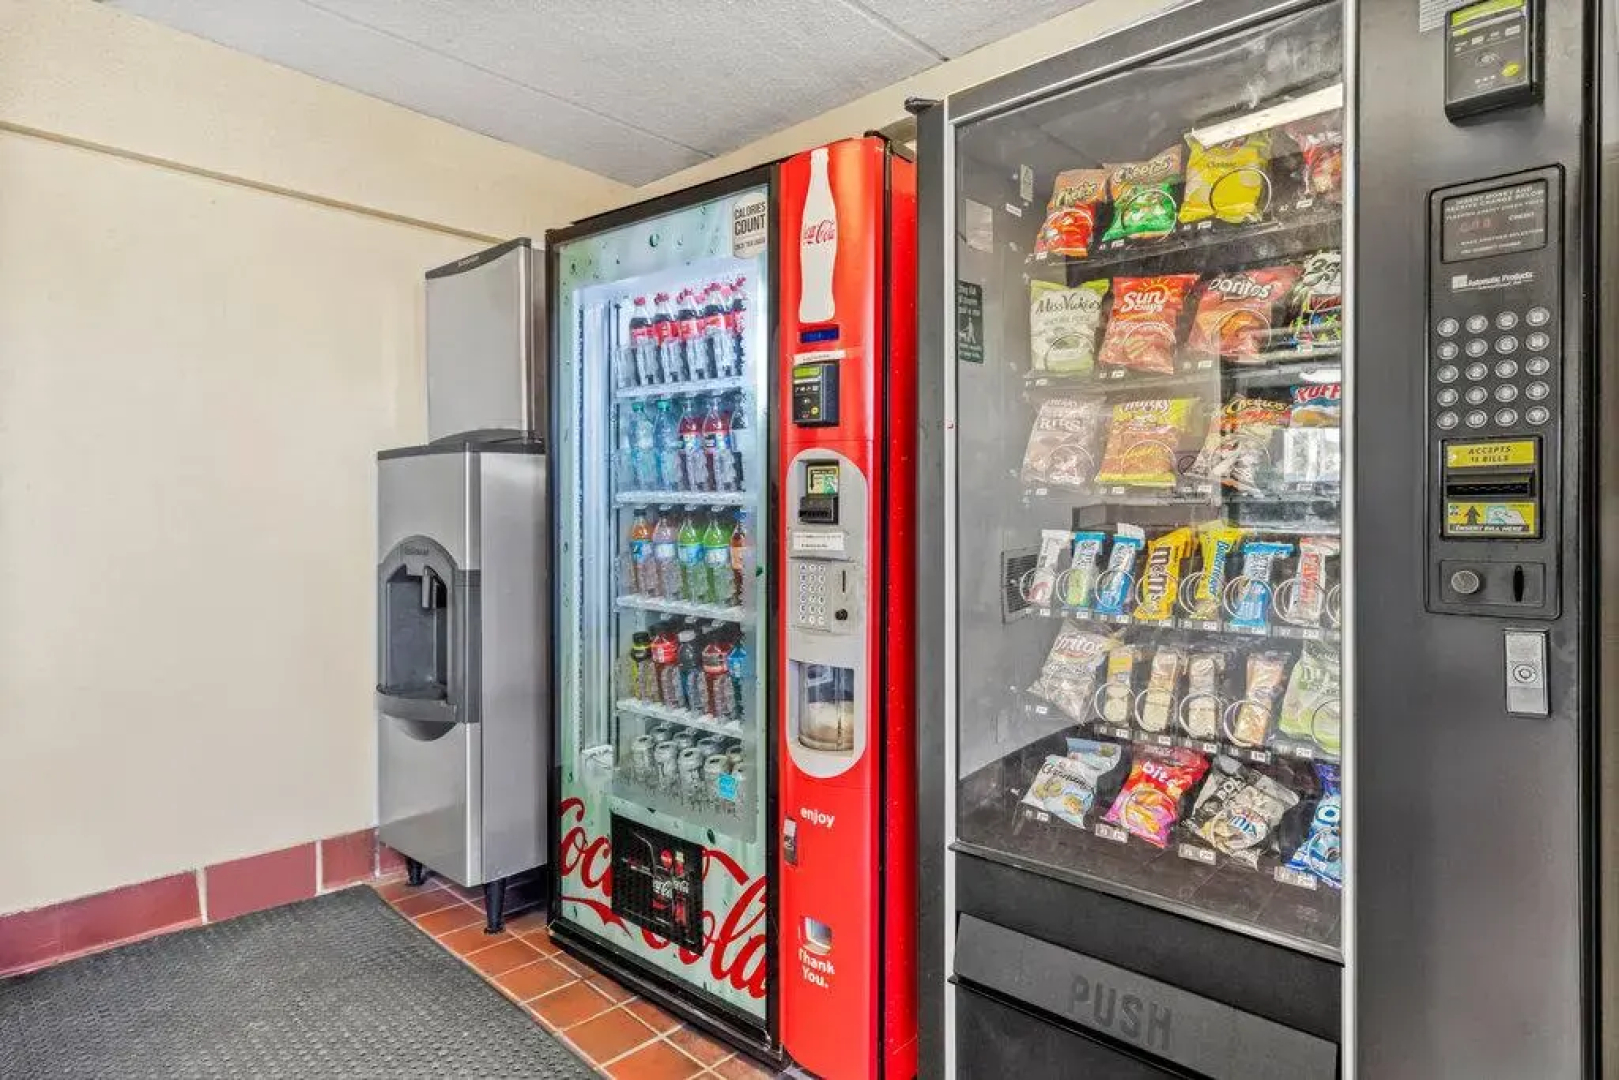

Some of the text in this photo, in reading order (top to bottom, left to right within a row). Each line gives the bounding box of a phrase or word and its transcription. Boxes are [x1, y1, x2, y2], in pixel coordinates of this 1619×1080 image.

[734, 201, 766, 219] CALORIES
[734, 213, 766, 236] COUNT
[1208, 276, 1273, 298] Doritos
[1468, 445, 1511, 455] ACCEPTS
[800, 807, 836, 828] enjoy
[799, 948, 835, 975] Thank
[1069, 973, 1175, 1052] PUSH
